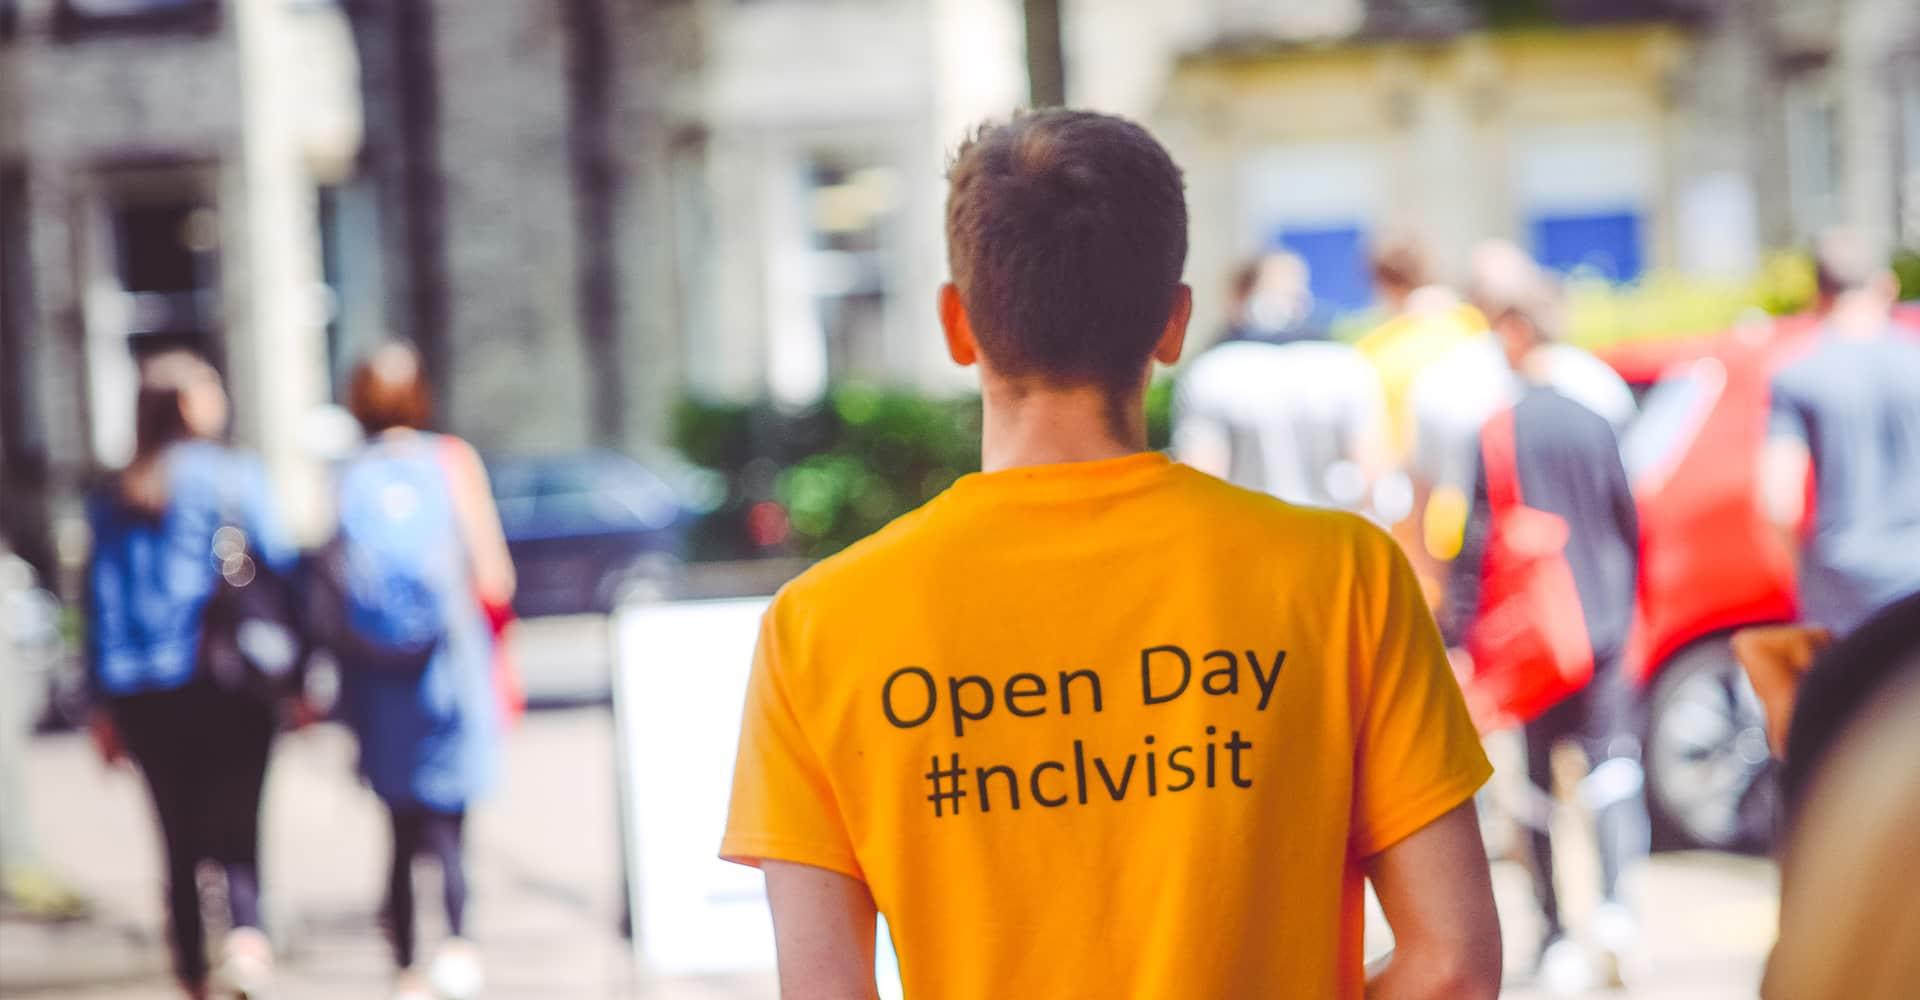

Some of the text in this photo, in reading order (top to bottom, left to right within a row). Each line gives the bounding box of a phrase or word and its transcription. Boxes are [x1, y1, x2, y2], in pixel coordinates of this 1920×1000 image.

[882, 645, 1287, 737] Open Day
[925, 725, 1254, 817] #nclvisit
